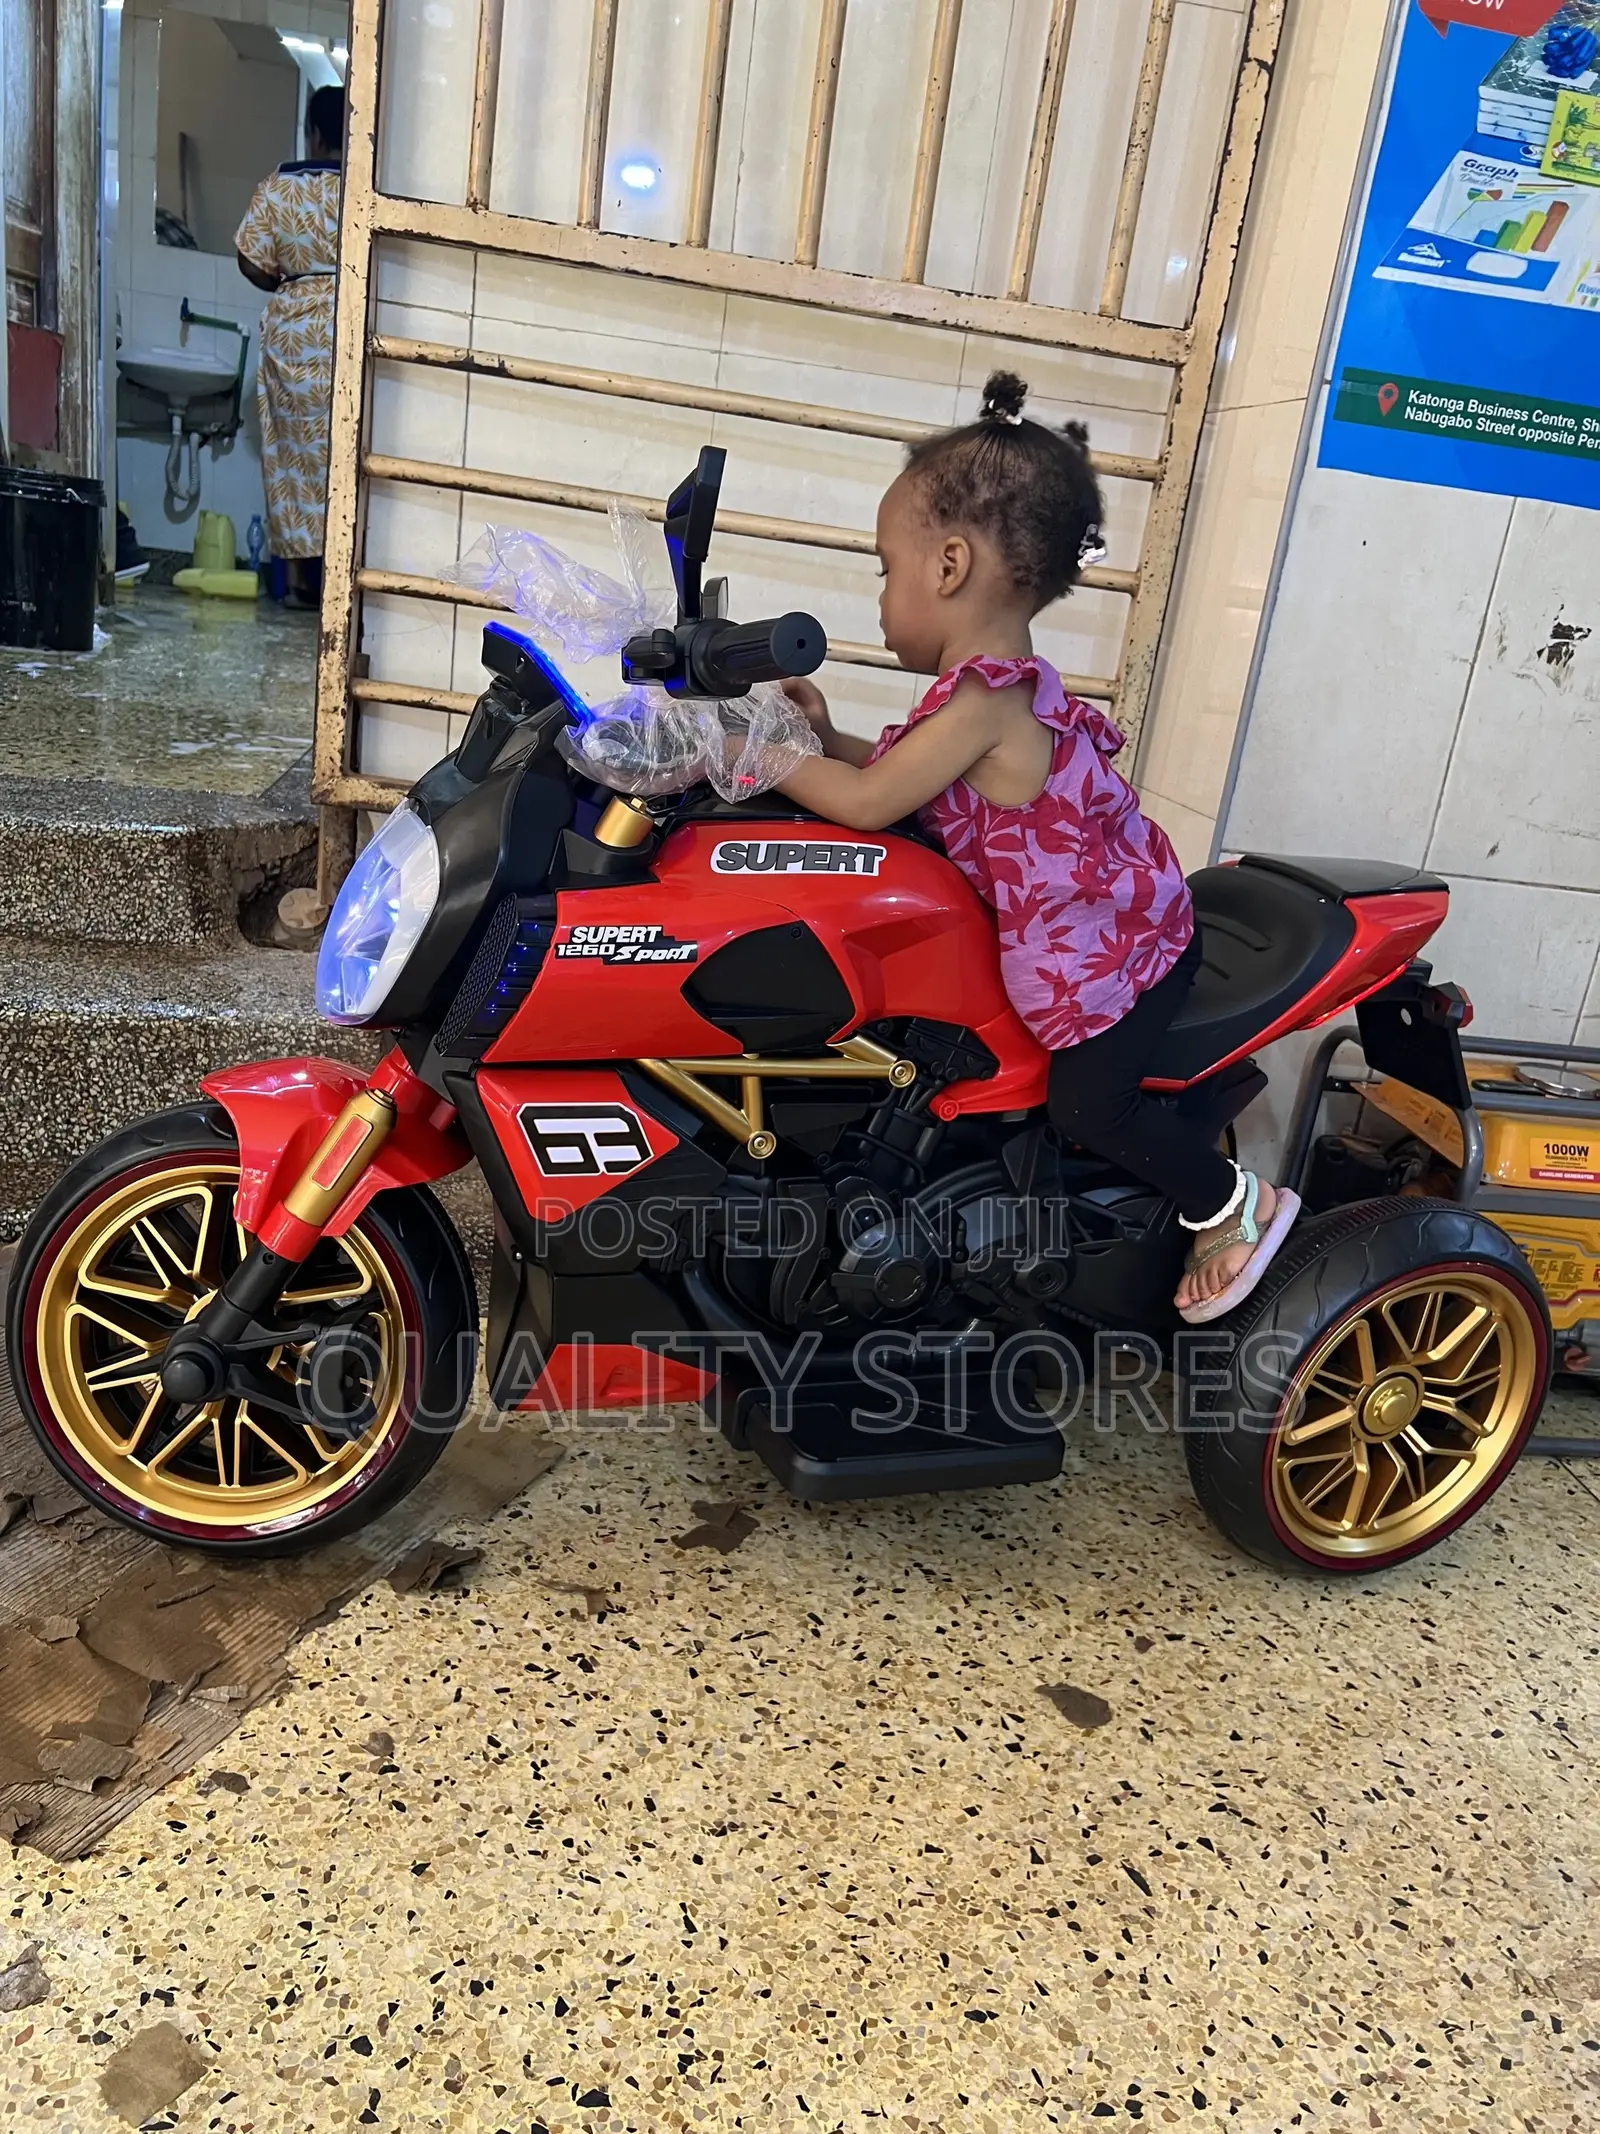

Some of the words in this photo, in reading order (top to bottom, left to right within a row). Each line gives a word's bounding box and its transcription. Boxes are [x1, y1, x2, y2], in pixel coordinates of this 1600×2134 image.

[1463, 158, 1519, 179] Graph
[1408, 389, 1465, 413] Katonga
[1467, 398, 1529, 422] Business
[1532, 409, 1578, 432] Centre,
[1404, 405, 1473, 429] Nabugabo
[1475, 417, 1516, 436] Street
[1518, 426, 1576, 446] opposite
[716, 842, 884, 874] SUPERT
[571, 925, 663, 944] SUPERT
[556, 943, 616, 956] 1260
[517, 1103, 654, 1177] 63
[1543, 1143, 1590, 1157] 1000W
